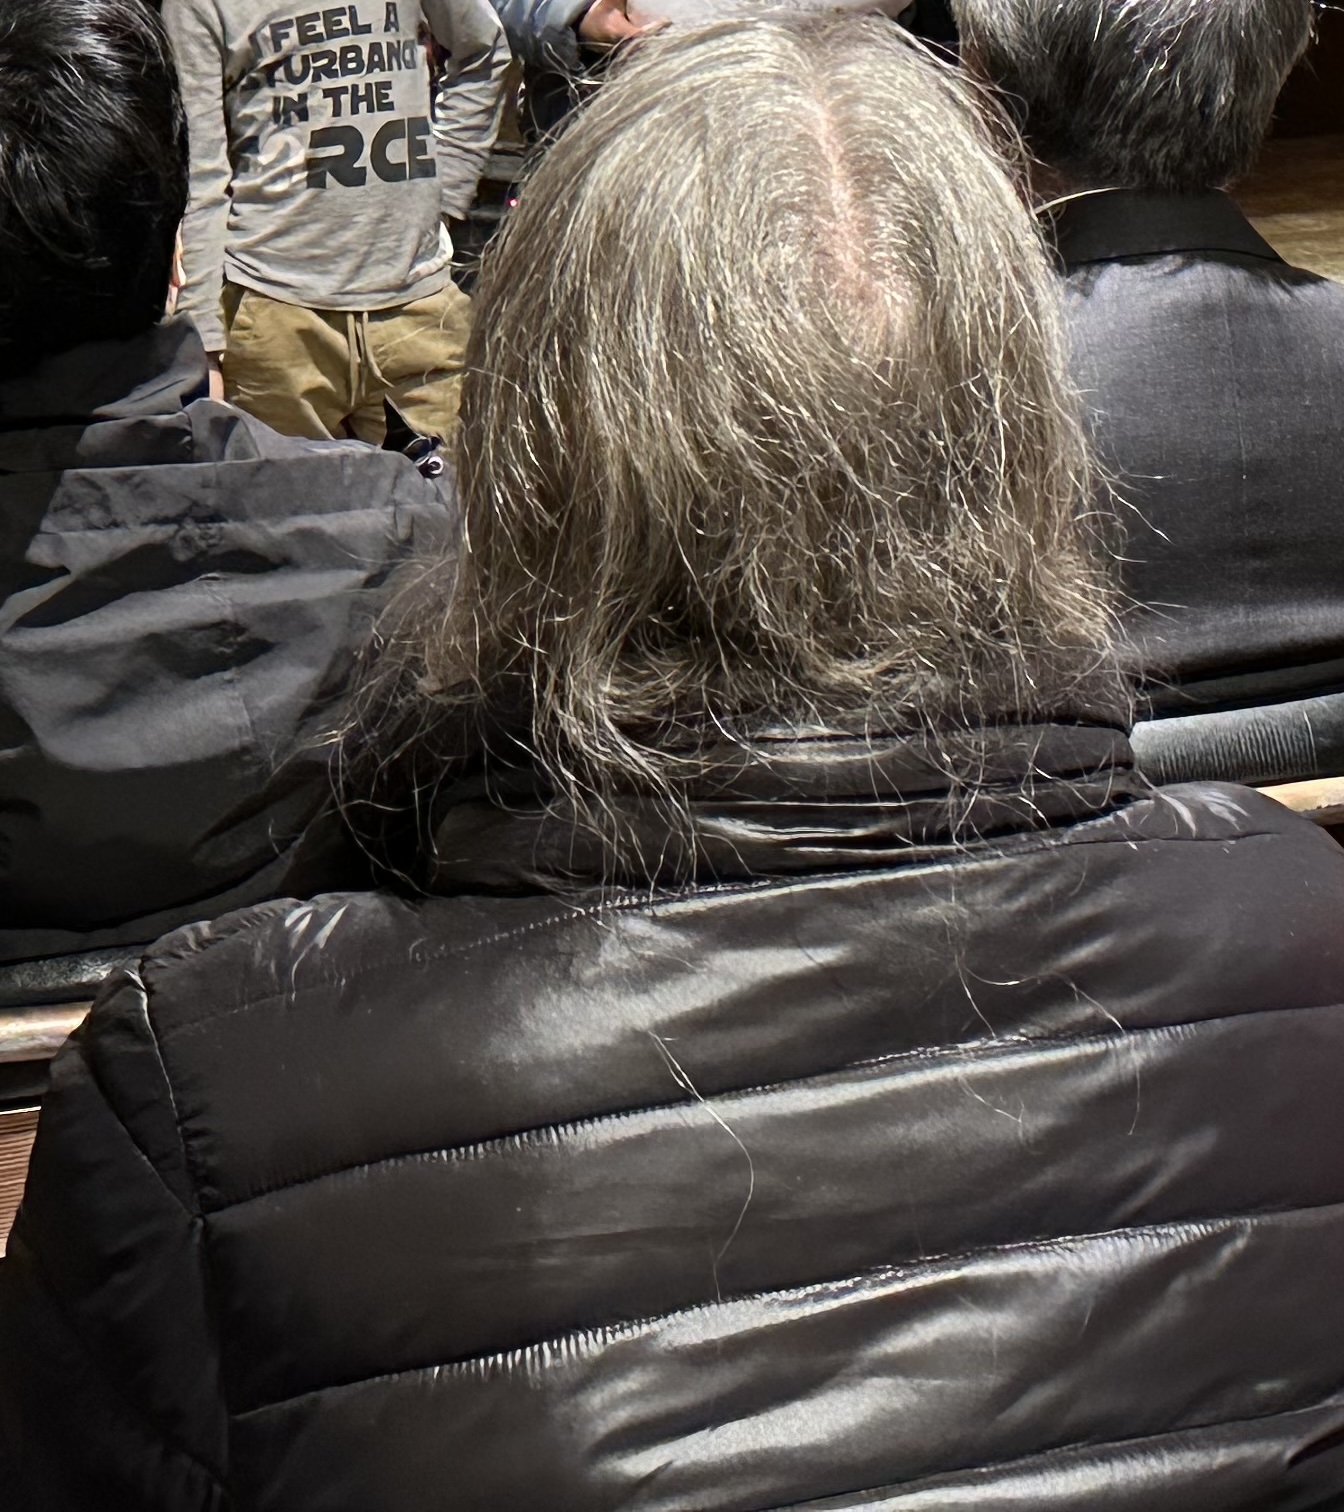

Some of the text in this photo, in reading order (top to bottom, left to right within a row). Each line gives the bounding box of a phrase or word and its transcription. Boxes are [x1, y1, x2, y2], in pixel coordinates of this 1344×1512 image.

[269, 5, 372, 54] FEEL
[383, 1, 400, 33] A
[272, 80, 395, 128] IN THE
